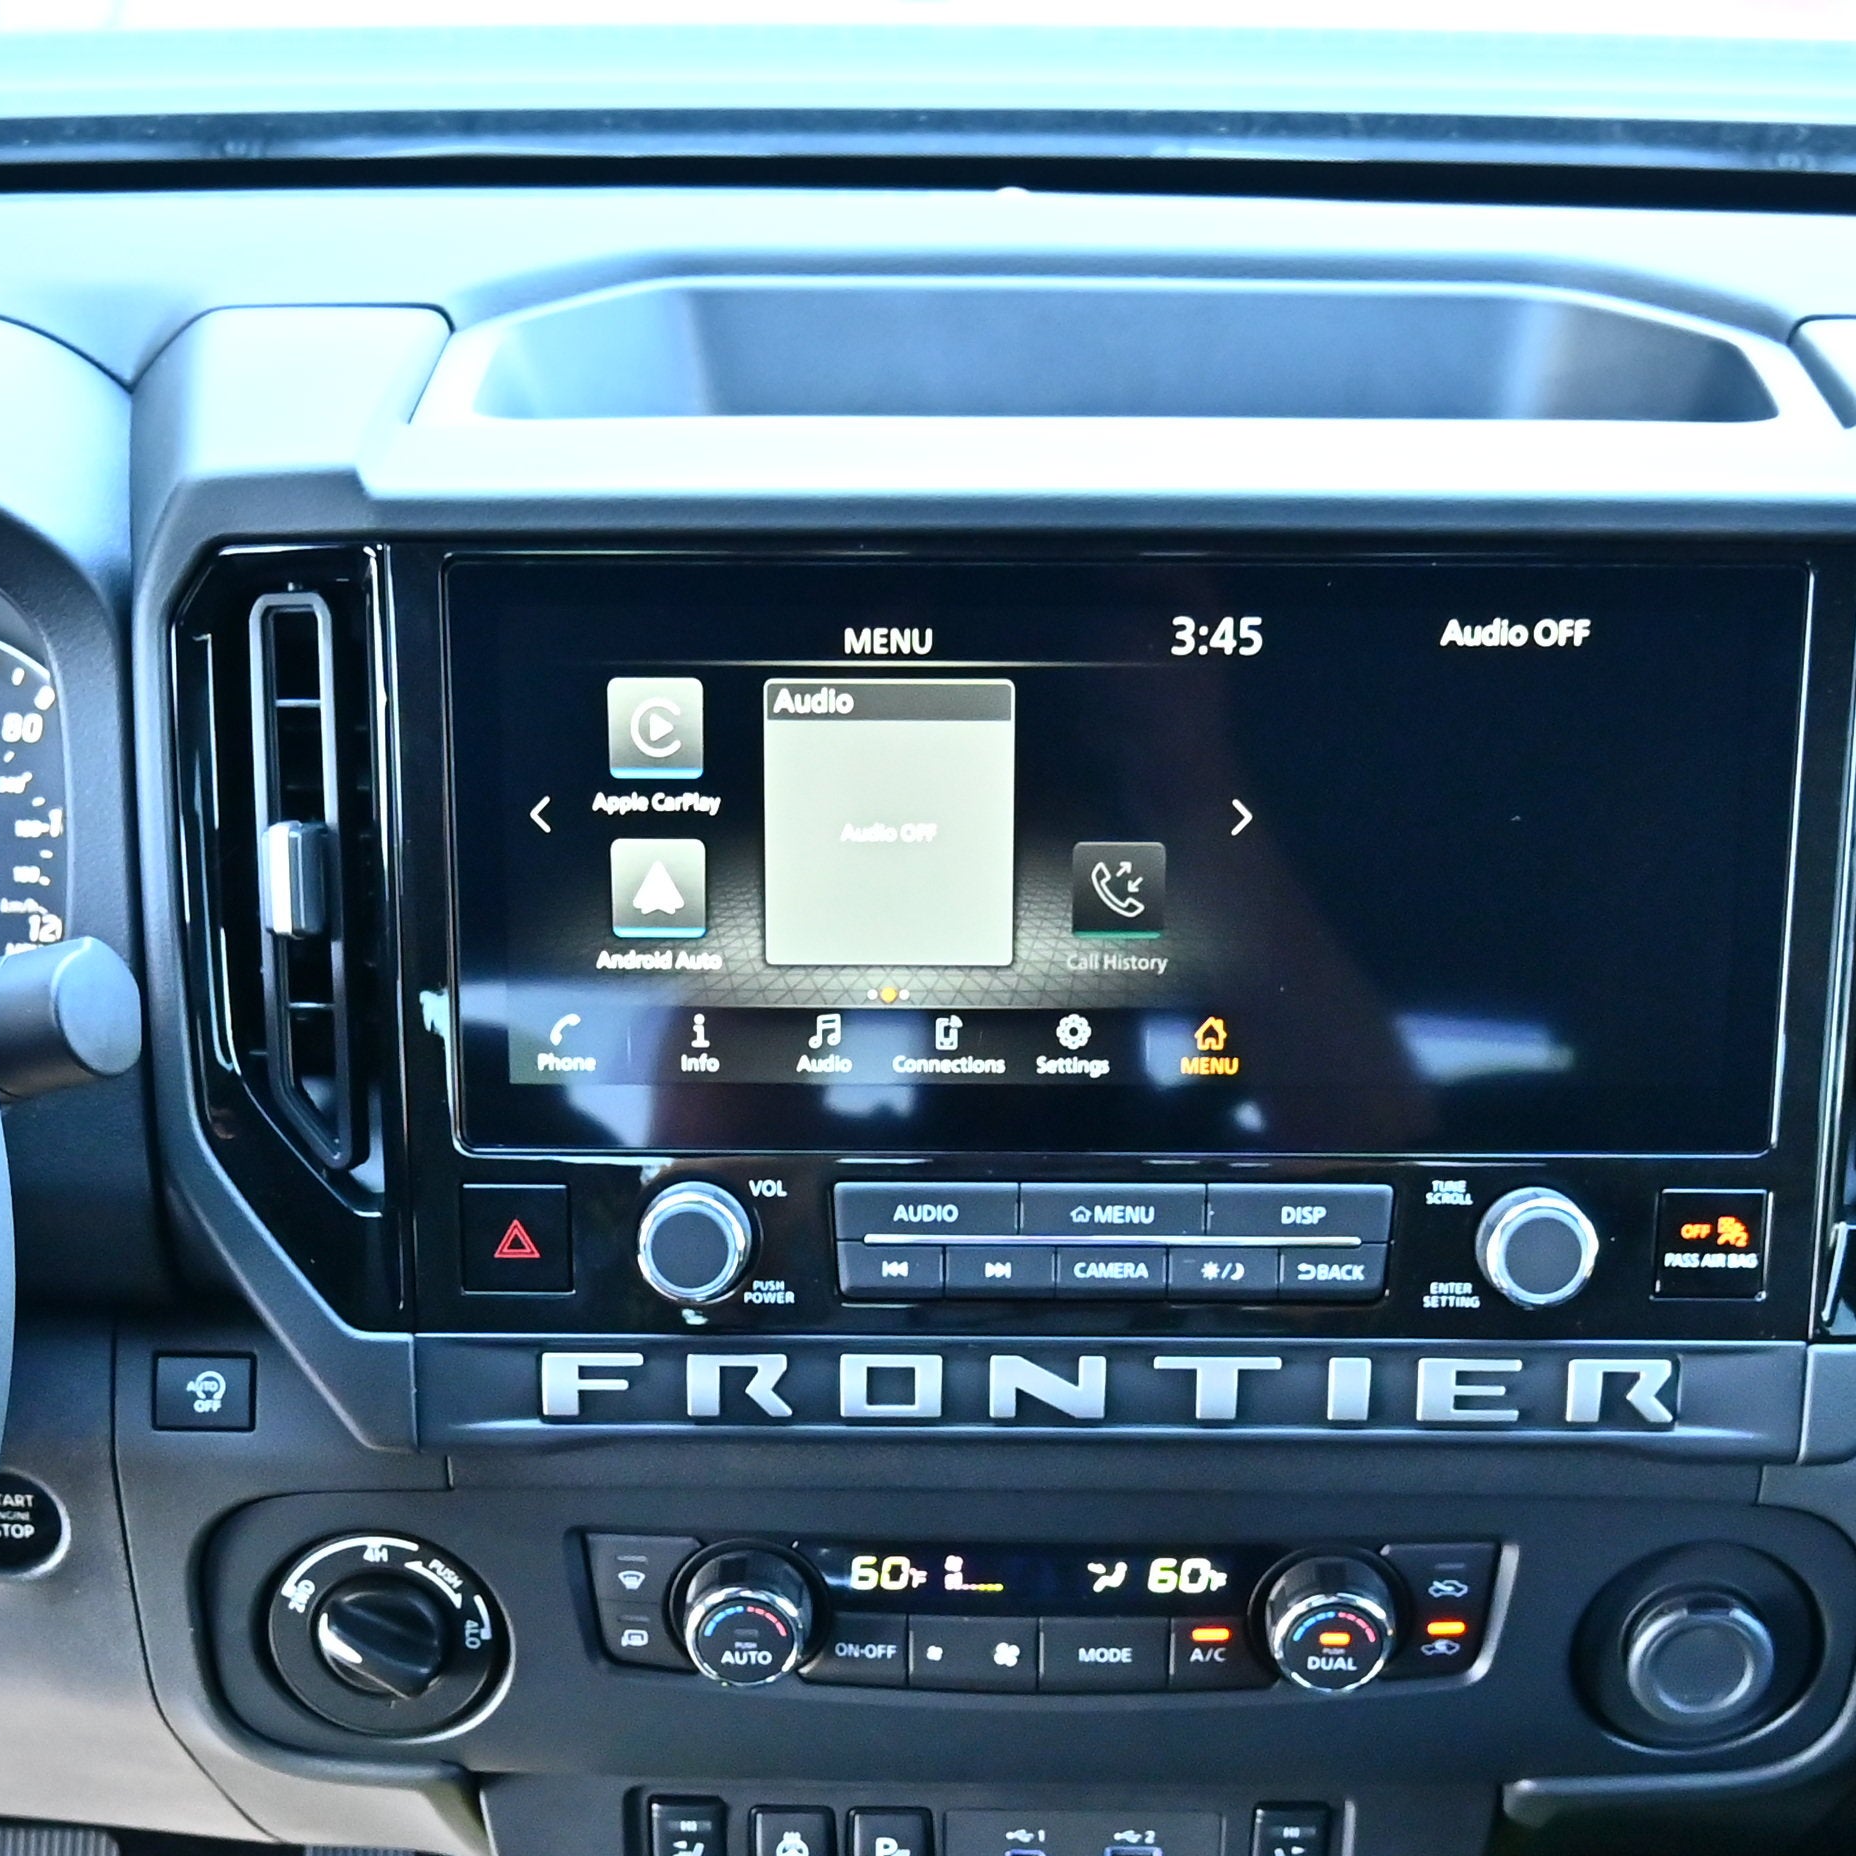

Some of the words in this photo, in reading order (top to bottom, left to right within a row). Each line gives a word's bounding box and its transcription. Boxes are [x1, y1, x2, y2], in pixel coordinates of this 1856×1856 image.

[844, 627, 933, 656] MENU
[1170, 615, 1264, 657] 3:45
[1440, 617, 1530, 649] Audio
[1533, 617, 1591, 649] OFF
[773, 687, 854, 716] Audio
[2, 712, 43, 743] 80
[592, 792, 649, 815] Apple
[651, 793, 721, 816] CarPlay
[840, 823, 897, 844] Audio
[901, 823, 938, 843] OFF
[597, 951, 673, 971] Android
[676, 951, 723, 971] Auto
[1066, 953, 1099, 973] Call
[1103, 953, 1168, 976] History
[537, 1053, 596, 1073] Phone
[680, 1053, 720, 1073] Info
[796, 1054, 852, 1073] Audio
[892, 1054, 1006, 1074] Connections
[1036, 1056, 1110, 1079] Settings
[1180, 1056, 1239, 1076] MENU
[748, 1179, 787, 1198] VOL
[1425, 1193, 1473, 1206] SCROLL
[893, 1204, 959, 1223] AUDIO
[1094, 1205, 1155, 1225] MENU
[1281, 1206, 1326, 1225] DISP
[1680, 1224, 1711, 1240] OFF
[1073, 1262, 1149, 1279] CAMERA
[1664, 1253, 1700, 1268] PASS
[1727, 1253, 1759, 1270] BAG
[1316, 1263, 1365, 1281] BACK
[752, 1281, 785, 1291] PUSH
[1430, 1282, 1472, 1295] ENTER
[744, 1291, 795, 1304] POWER
[1422, 1296, 1480, 1309] SETTING
[541, 1352, 1678, 1424] FRONTIER
[193, 1399, 222, 1413] OFF
[363, 1547, 388, 1562] 4H
[428, 1558, 464, 1589] PUSH
[464, 1619, 481, 1650] 4LO
[721, 1650, 773, 1666] AUTO
[1078, 1648, 1132, 1663] MODE
[1190, 1647, 1227, 1663] A/C
[1307, 1655, 1357, 1672] DUAL
[1037, 1830, 1046, 1842] 1
[1144, 1830, 1155, 1844] 2
